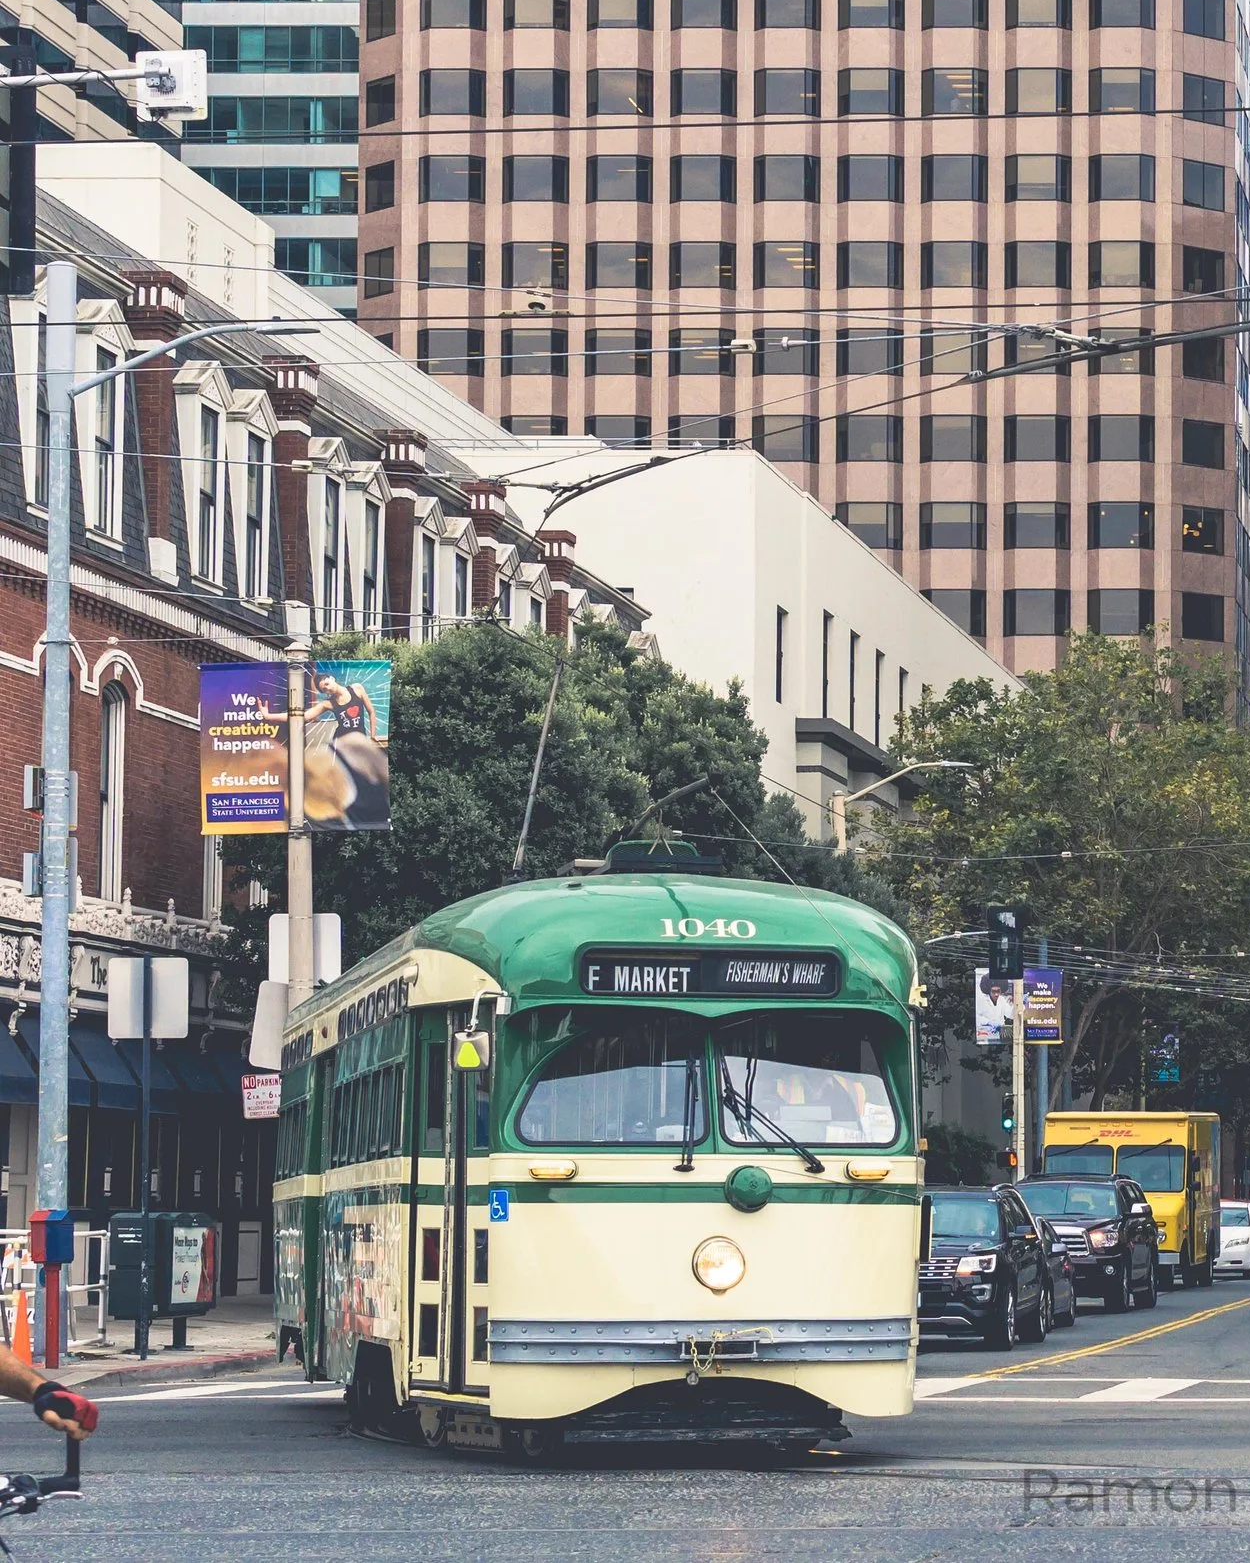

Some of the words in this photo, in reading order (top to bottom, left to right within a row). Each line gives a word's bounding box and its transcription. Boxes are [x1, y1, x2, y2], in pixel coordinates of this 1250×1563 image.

[231, 693, 256, 706] We
[223, 707, 264, 721] make
[208, 723, 280, 738] creativity
[213, 738, 275, 754] happen.
[211, 771, 280, 787] sfsu.edu
[212, 798, 230, 806] SAN
[231, 797, 280, 806] FRANCISCO
[212, 808, 234, 816] STATE
[235, 808, 279, 816] UNIVERSITY
[660, 918, 757, 939] 1040
[588, 965, 600, 990] F
[614, 965, 691, 993] MARKET
[726, 961, 789, 985] FISHERMAN'S
[792, 964, 826, 985] WHARF
[243, 1076, 256, 1089] NO
[1099, 1129, 1134, 1137] DHL
